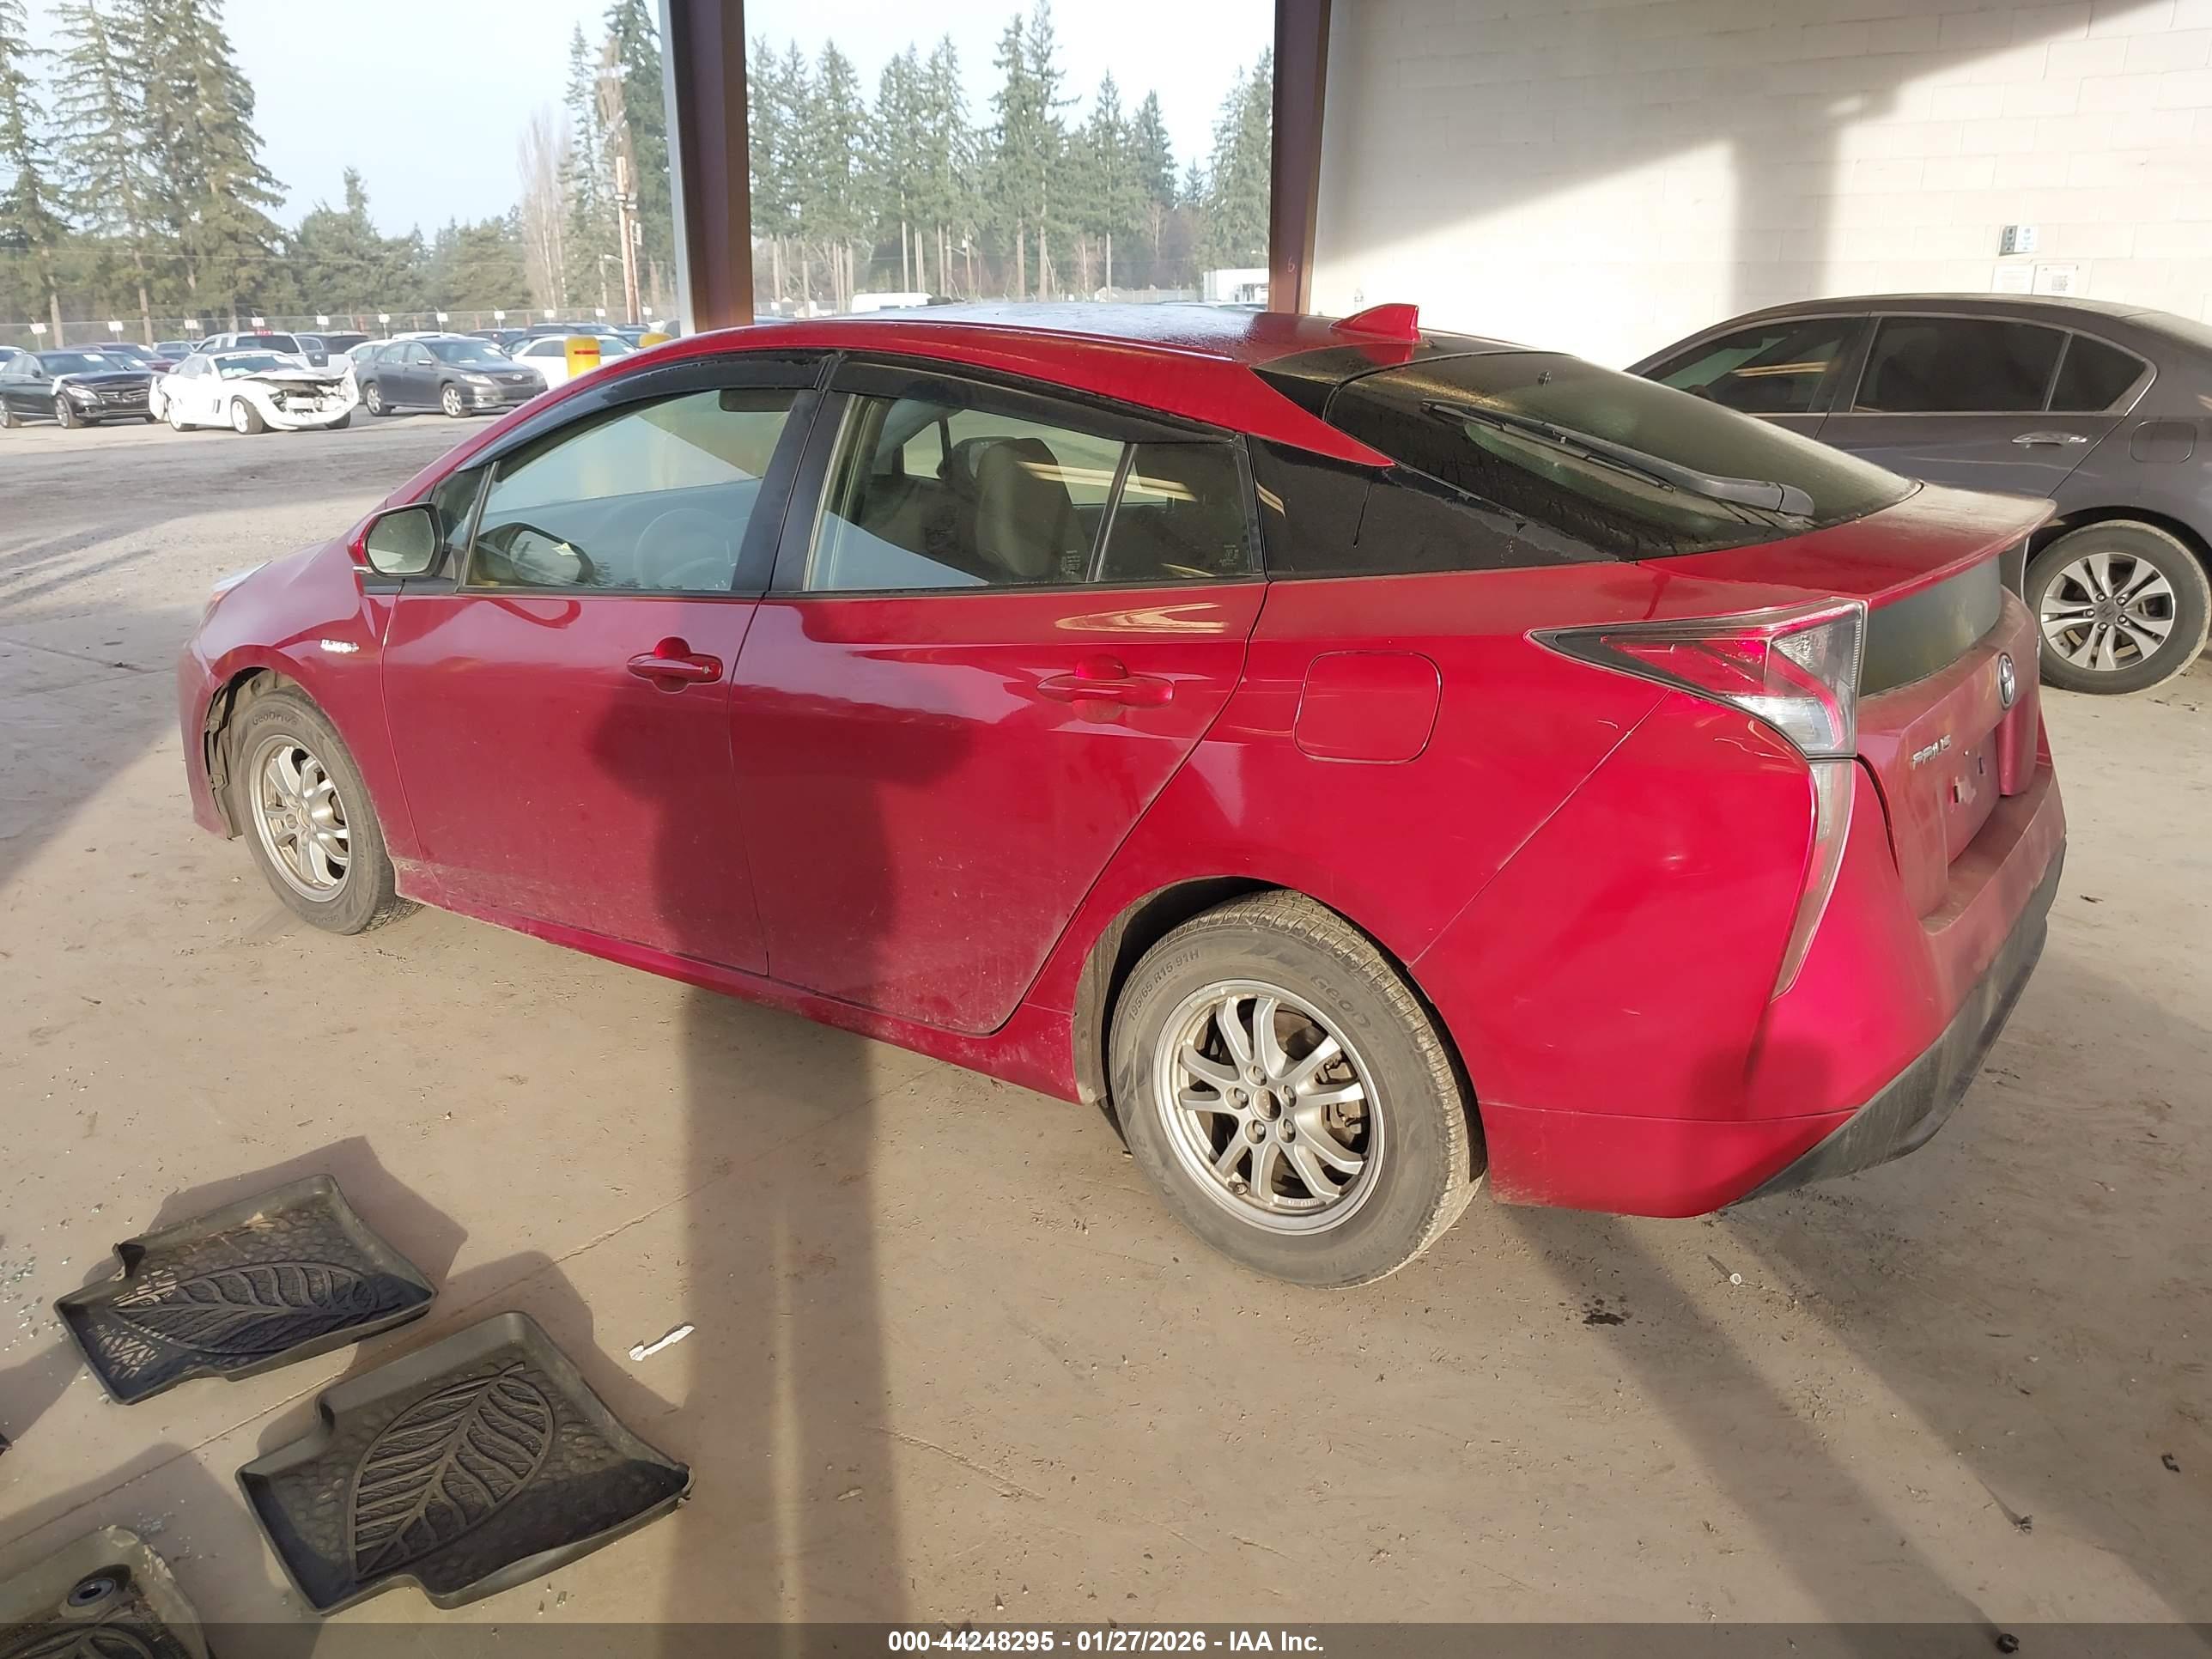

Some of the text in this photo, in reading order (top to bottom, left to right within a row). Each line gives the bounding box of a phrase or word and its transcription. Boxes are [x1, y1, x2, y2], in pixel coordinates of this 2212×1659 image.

[1127, 948, 1200, 1021] 195/65 R15 91H
